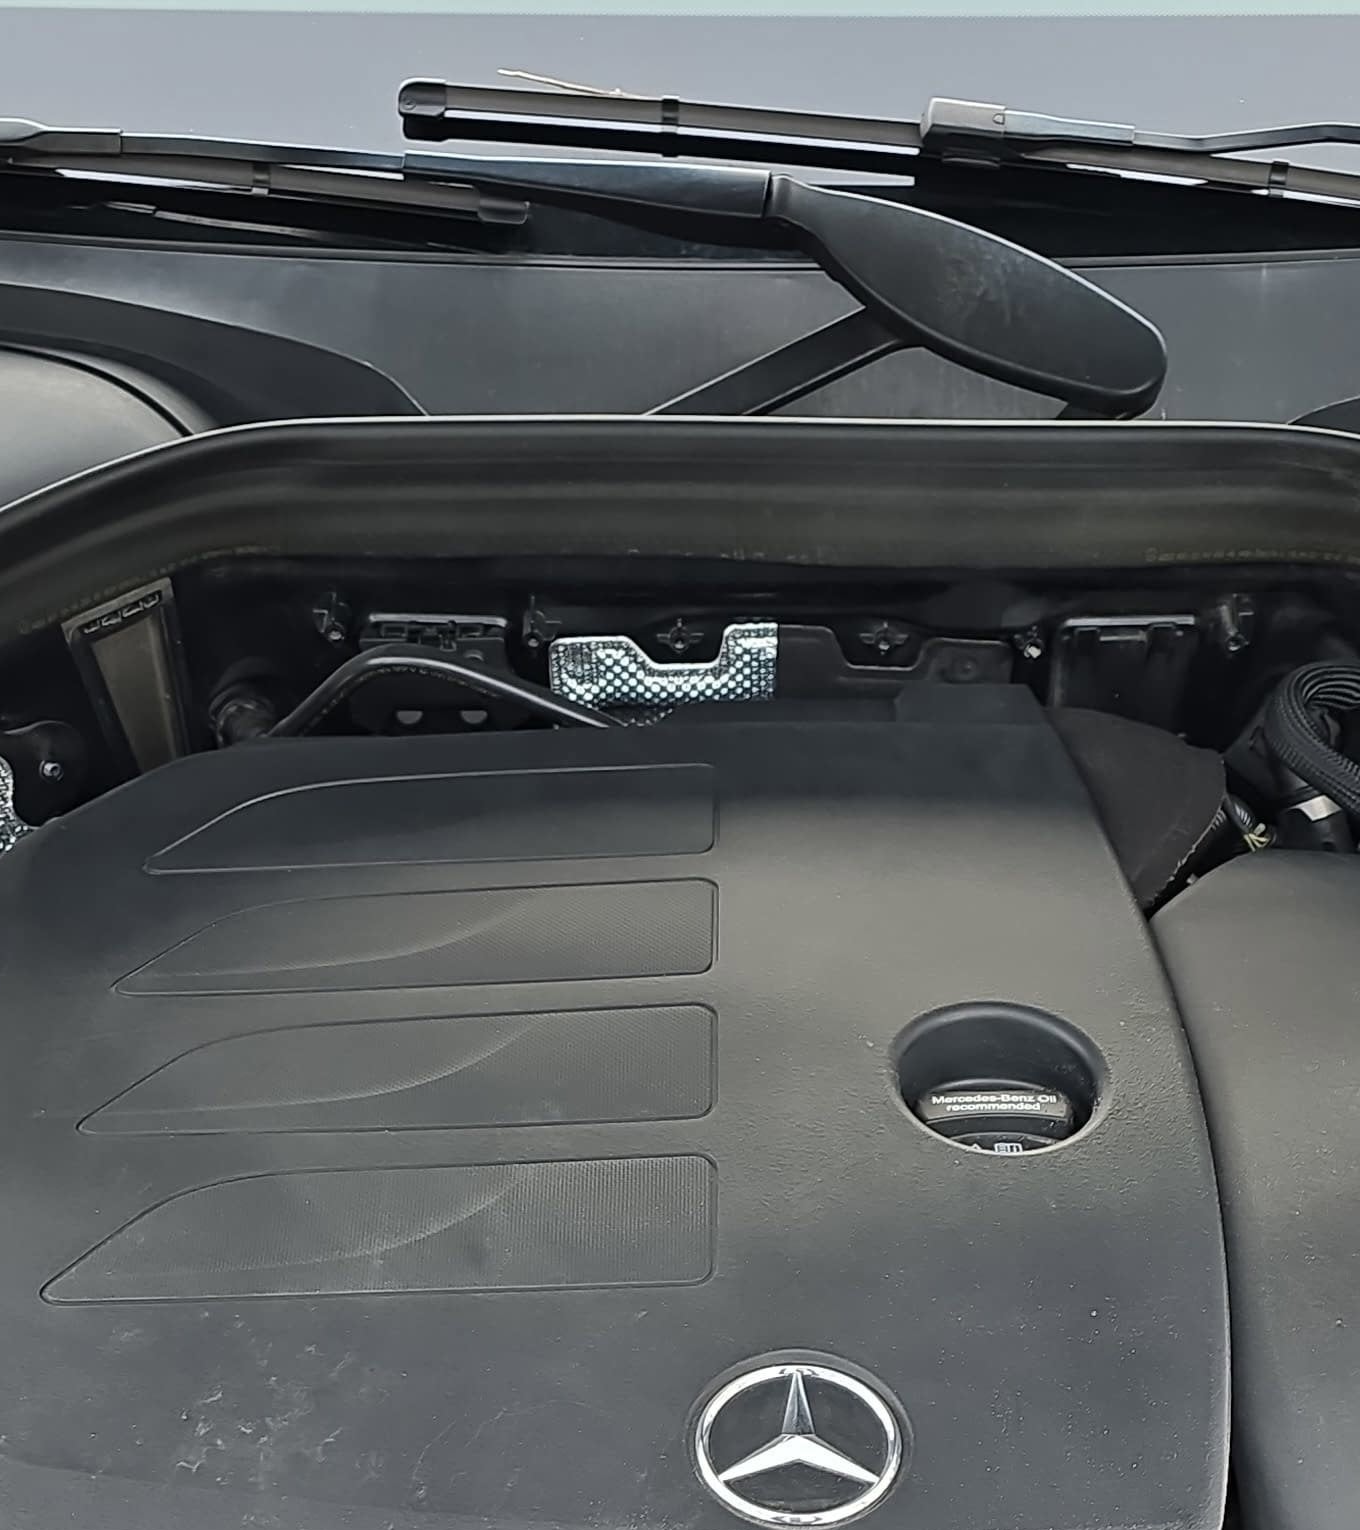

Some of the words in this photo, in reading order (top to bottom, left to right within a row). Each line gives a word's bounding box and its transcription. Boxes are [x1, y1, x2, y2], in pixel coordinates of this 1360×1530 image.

[931, 1094, 1035, 1104] Mercedes-Benz
[1037, 1094, 1057, 1103] Oil
[946, 1102, 1040, 1112] recommended
